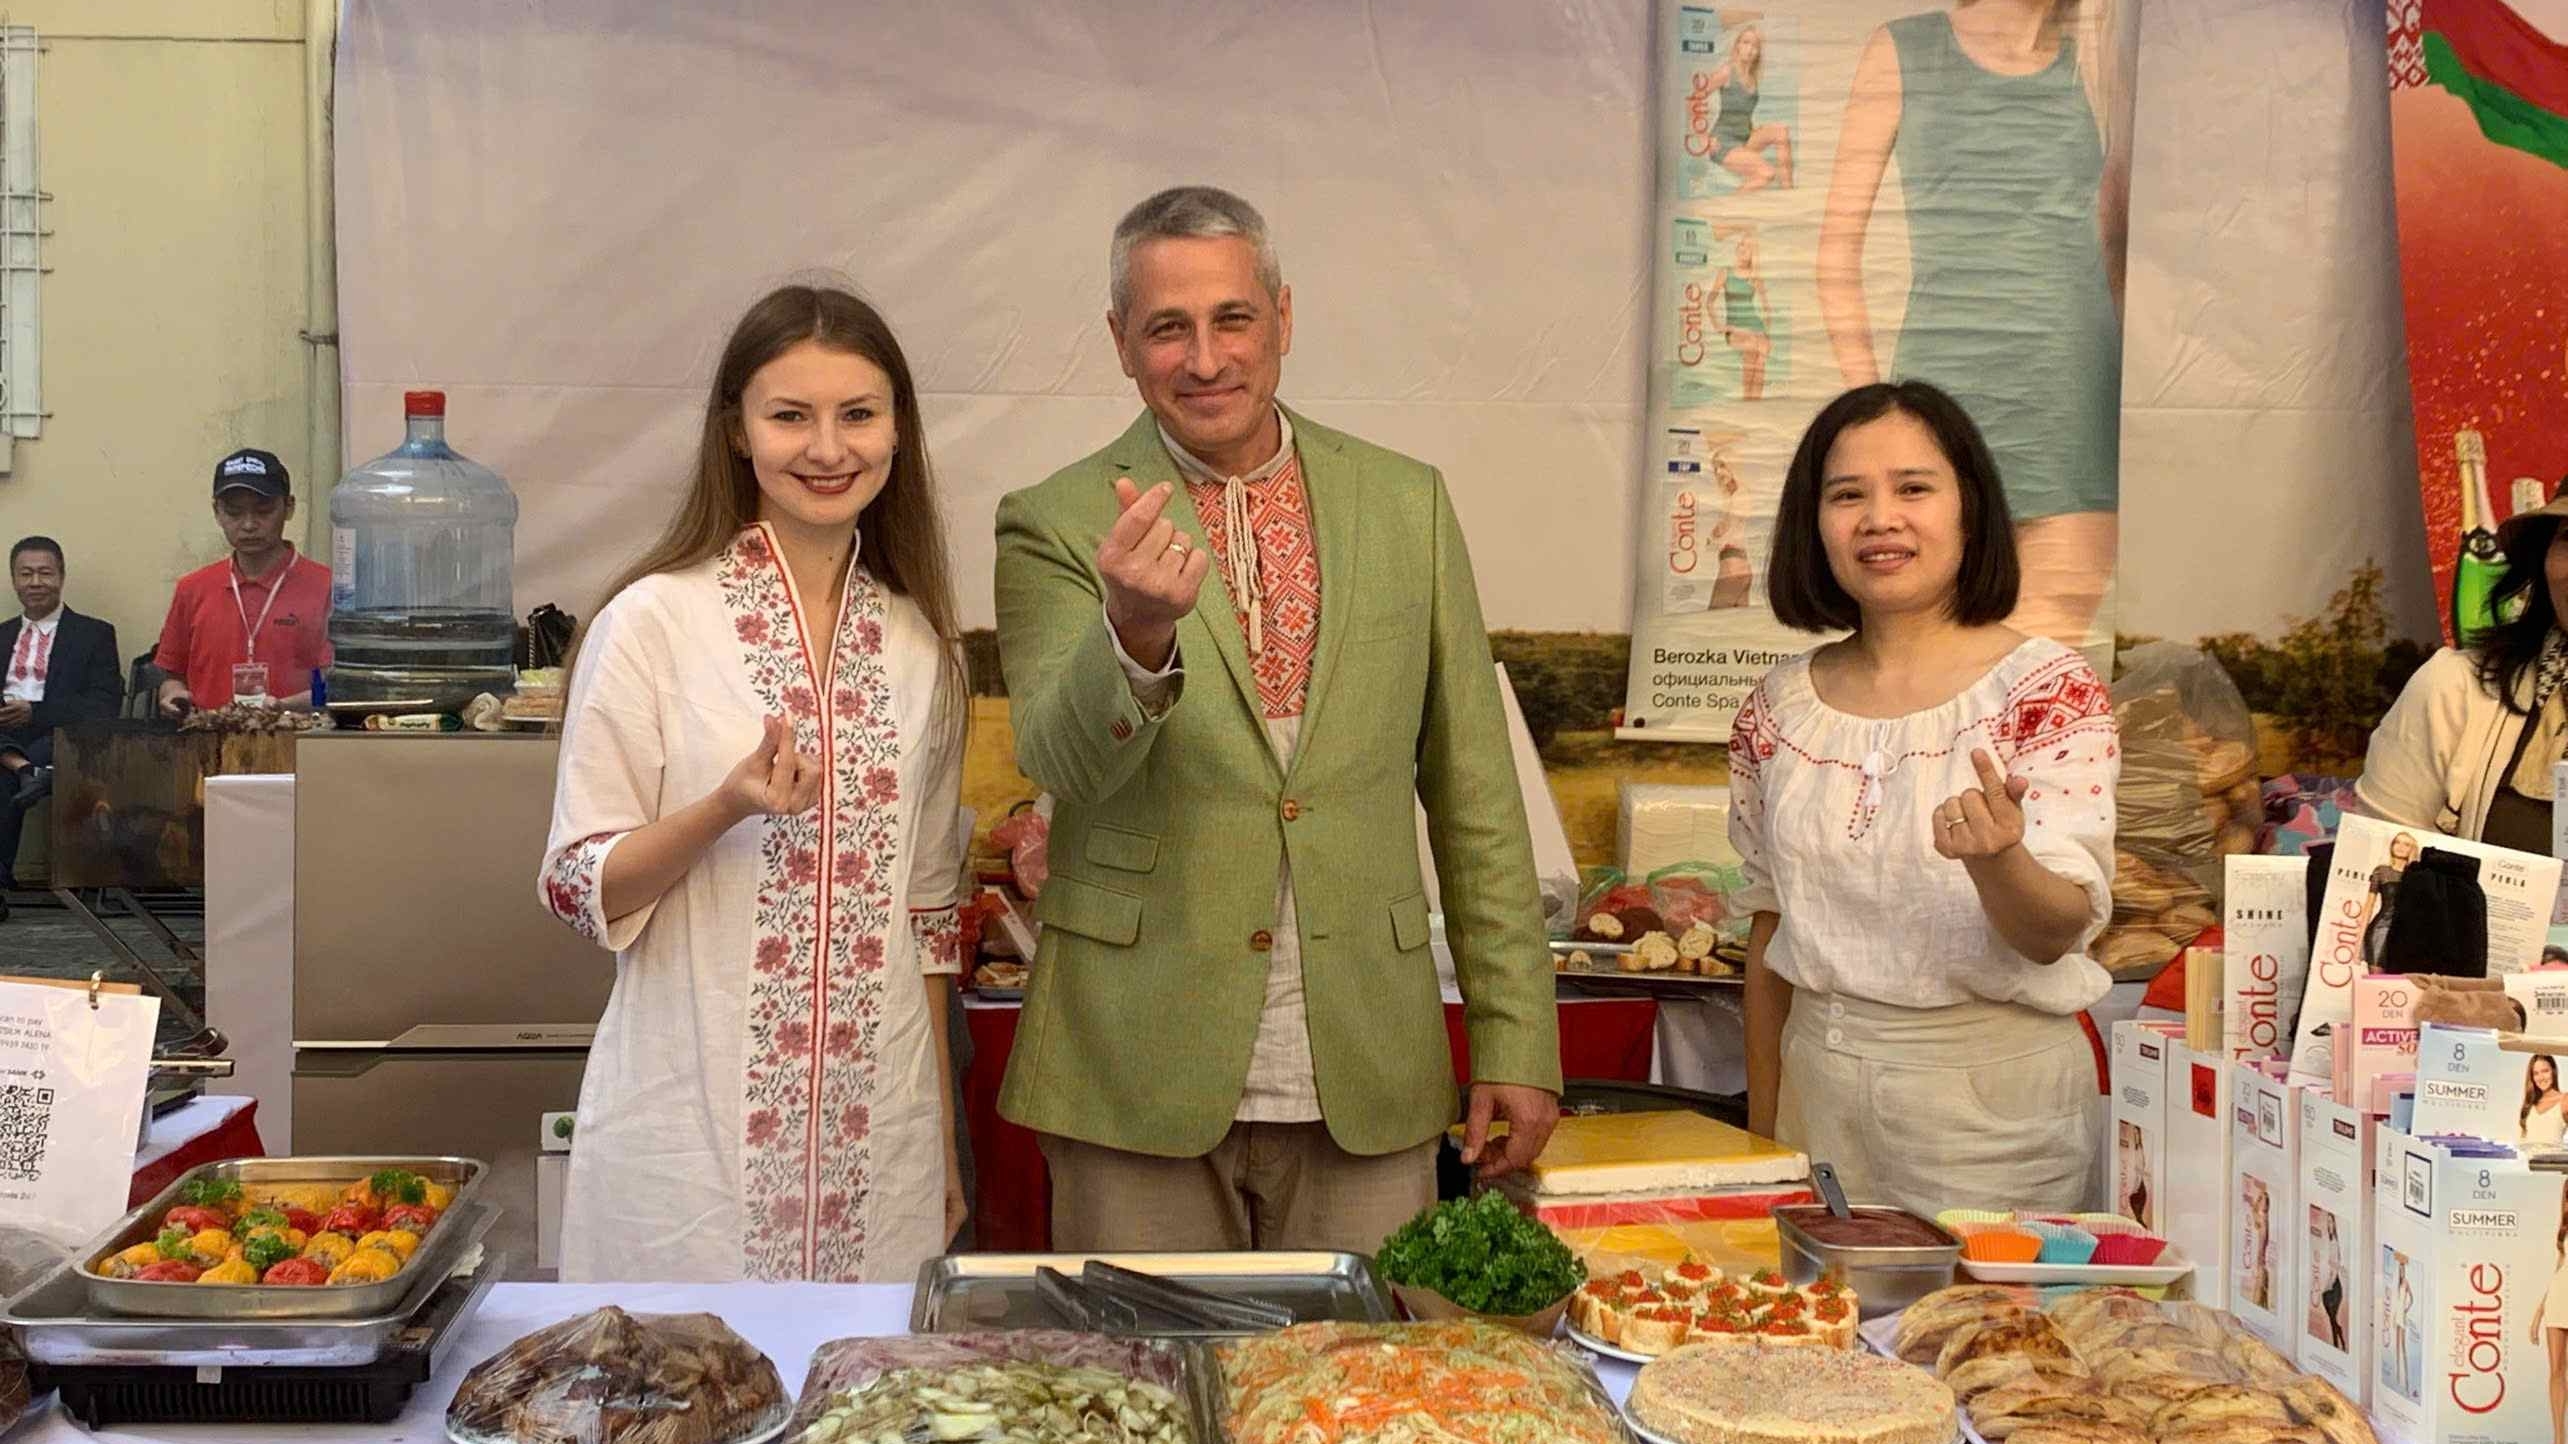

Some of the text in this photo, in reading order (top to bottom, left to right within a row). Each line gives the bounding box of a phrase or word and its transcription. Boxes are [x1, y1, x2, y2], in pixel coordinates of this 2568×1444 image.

[1684, 73, 1710, 156] Conte
[1678, 282, 1704, 366] Conte
[1669, 491, 1697, 573] Conte
[1654, 648, 1800, 664] Berozka Vietna
[1652, 671, 1766, 688] официальны
[1652, 692, 1702, 709] Conte
[2491, 873, 2526, 888] PERLA
[2236, 909, 2283, 921] SHINE
[2320, 900, 2362, 988] Conte
[2233, 954, 2278, 1060] onte
[2378, 990, 2408, 1008] 20
[2382, 1009, 2403, 1018] DEN
[2365, 1031, 2418, 1042] ACTIVE
[2397, 1043, 2417, 1056] SO
[2453, 1043, 2465, 1061] 8
[2447, 1062, 2470, 1073] DEN
[2427, 1083, 2487, 1099] SUMMER
[2478, 1169, 2491, 1188] 8
[2472, 1190, 2496, 1200] DEN
[2452, 1212, 2517, 1226] SUMMER
[2448, 1263, 2505, 1413] Conte
[2449, 1317, 2469, 1367] elegant
